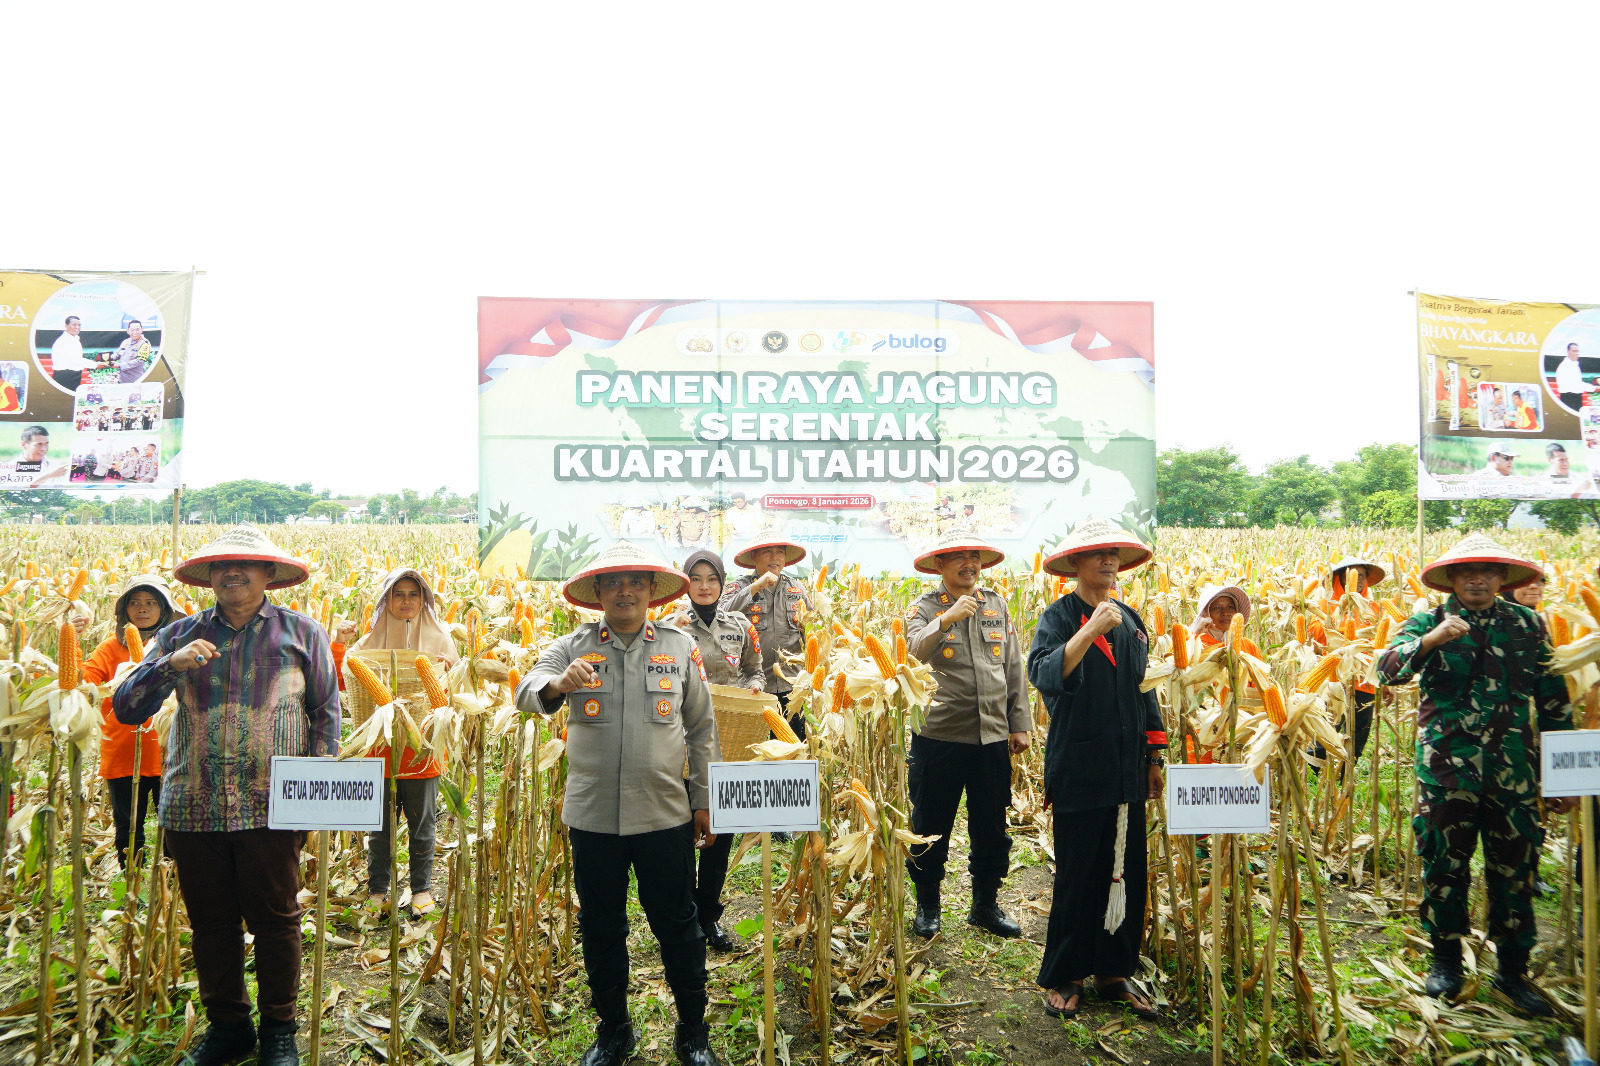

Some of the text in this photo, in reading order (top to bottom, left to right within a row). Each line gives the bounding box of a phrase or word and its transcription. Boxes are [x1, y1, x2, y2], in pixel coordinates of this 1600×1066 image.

[1454, 304, 1493, 315] Bergerak
[888, 334, 947, 352] bulog
[1420, 323, 1539, 346] BHAYANGKARA
[581, 374, 1053, 405] PANEN RAYA JAGUNG
[699, 411, 935, 441] SERENTAK
[559, 448, 1075, 479] KUARTAL I TAHUN 2026
[768, 497, 810, 507] Ponorogo,
[818, 497, 848, 506] Januari
[790, 535, 848, 543] PRESISI
[981, 620, 1002, 628] POLRI
[720, 633, 743, 643] POLRI
[647, 664, 681, 675] POLRI
[282, 780, 374, 801] KETUA DPRD PONOROGO
[718, 778, 811, 809] KAPOLRES PONOROGO
[1177, 785, 1260, 806] Plt. BUPATI PONOROGO
